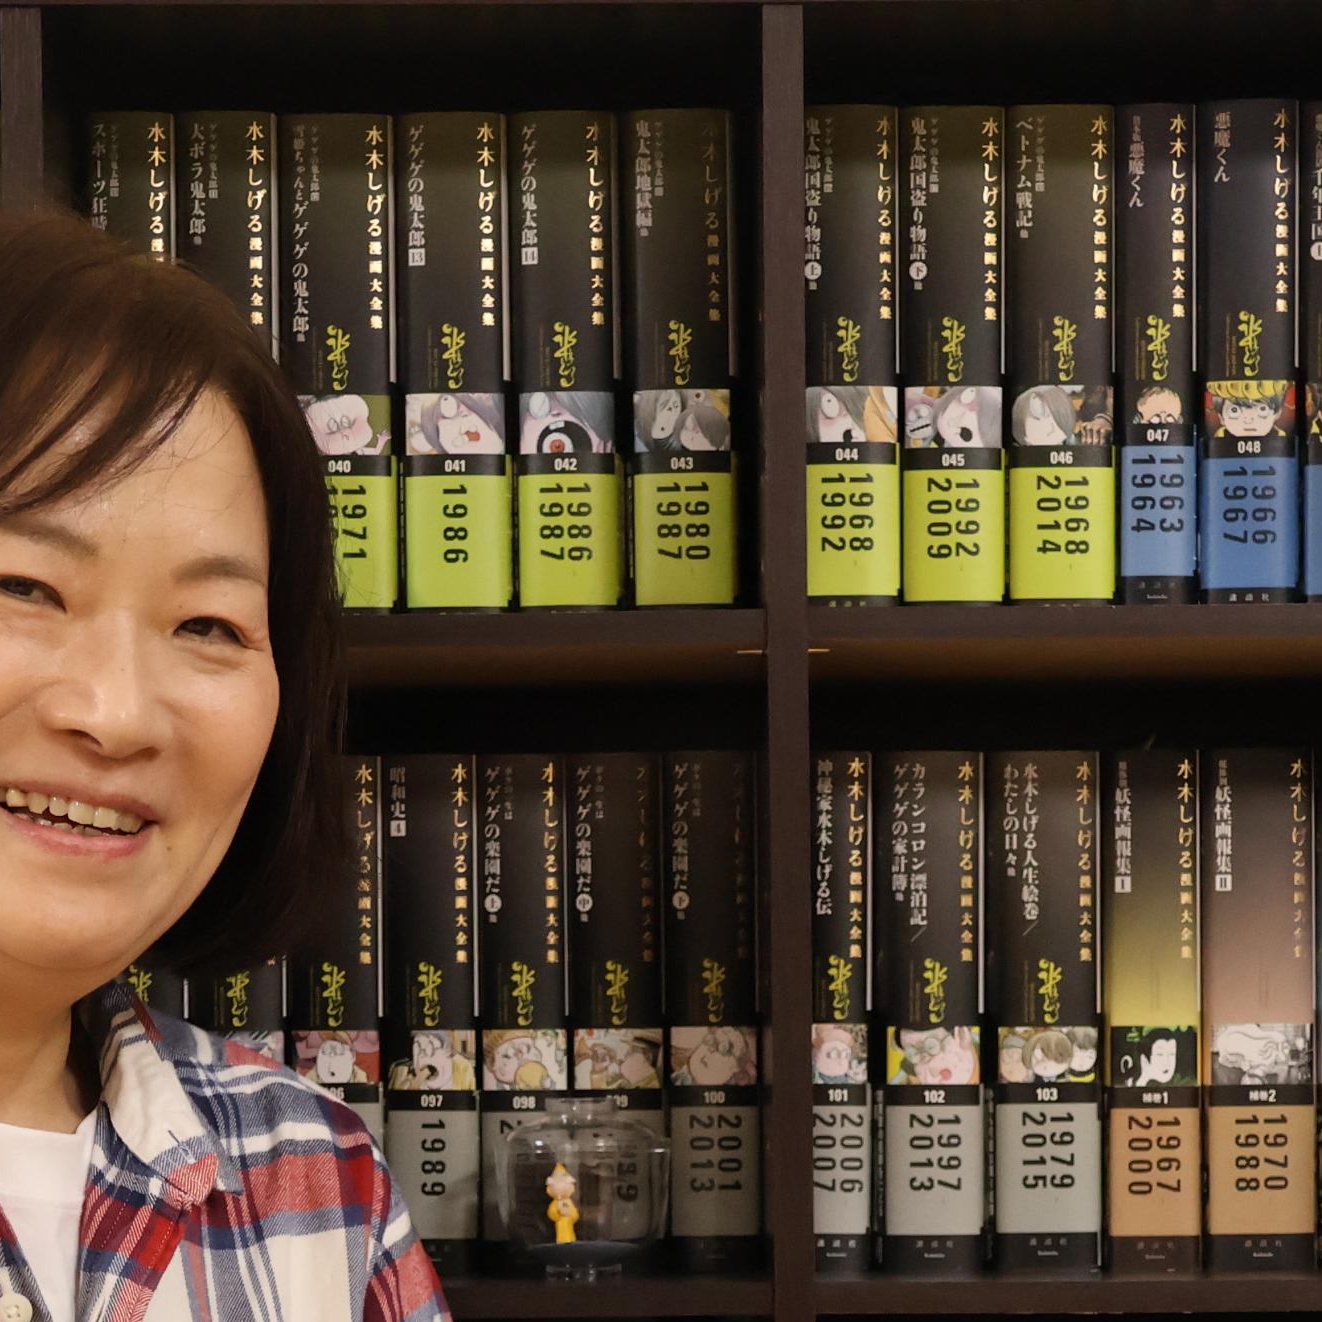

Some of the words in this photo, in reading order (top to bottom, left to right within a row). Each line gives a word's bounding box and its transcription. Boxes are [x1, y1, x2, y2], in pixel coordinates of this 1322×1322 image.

[445, 460, 466, 472] 041
[555, 459, 577, 471] 042
[671, 457, 693, 470] 043
[836, 448, 859, 461] 044
[942, 455, 964, 467] 045
[1050, 452, 1073, 465] 046
[1147, 429, 1168, 442] 047
[1238, 441, 1261, 454] 048
[443, 483, 468, 564] 1986
[540, 482, 563, 562] 1987
[567, 482, 591, 562] 1986
[657, 481, 681, 561] 1987
[821, 475, 846, 551] 1992
[927, 478, 951, 559] 2009
[1036, 477, 1062, 554] 2014
[1159, 455, 1184, 533] 1963
[1223, 466, 1247, 543] 1967
[421, 1095, 443, 1107] 097
[828, 1089, 849, 1102] 101
[924, 1090, 945, 1103] 102
[1036, 1089, 1058, 1101] 103
[421, 1120, 446, 1197] 1989
[690, 1115, 715, 1194] 2013
[718, 1115, 742, 1192] 2001
[909, 1113, 934, 1192] 2013
[1049, 1112, 1074, 1191] 1979
[1127, 1115, 1152, 1195] 2000
[1156, 1115, 1181, 1194] 1967
